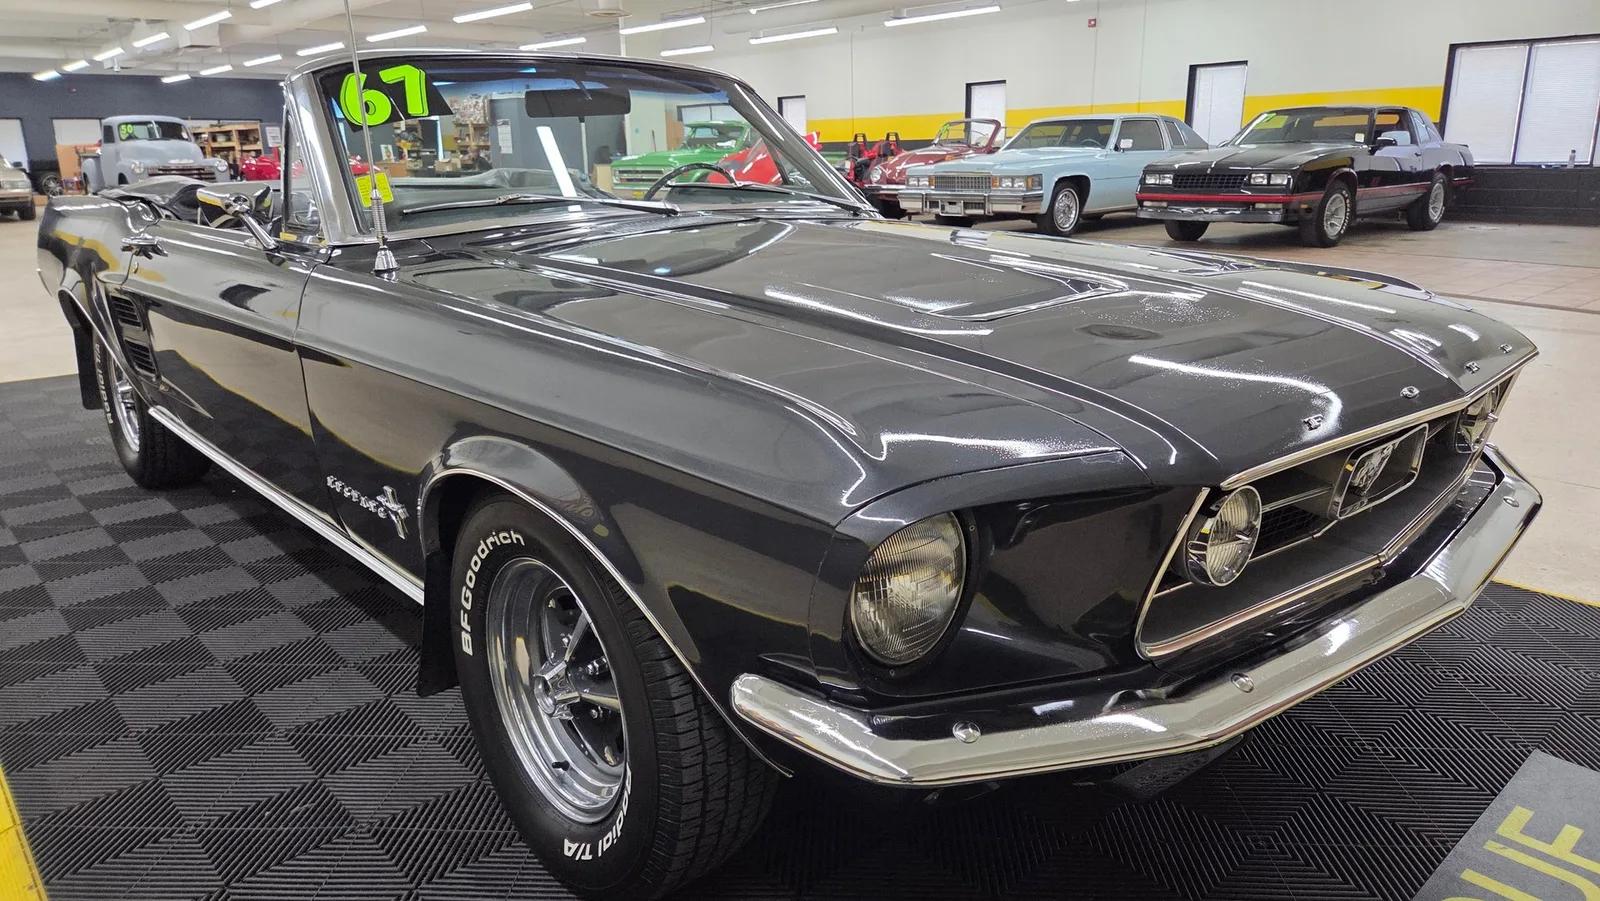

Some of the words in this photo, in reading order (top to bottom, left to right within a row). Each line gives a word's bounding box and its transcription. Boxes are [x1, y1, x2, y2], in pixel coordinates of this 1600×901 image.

[340, 64, 430, 126] 67
[460, 530, 525, 656] BFGoodrich
[598, 762, 632, 857] Radial
[563, 838, 593, 861] T/A
